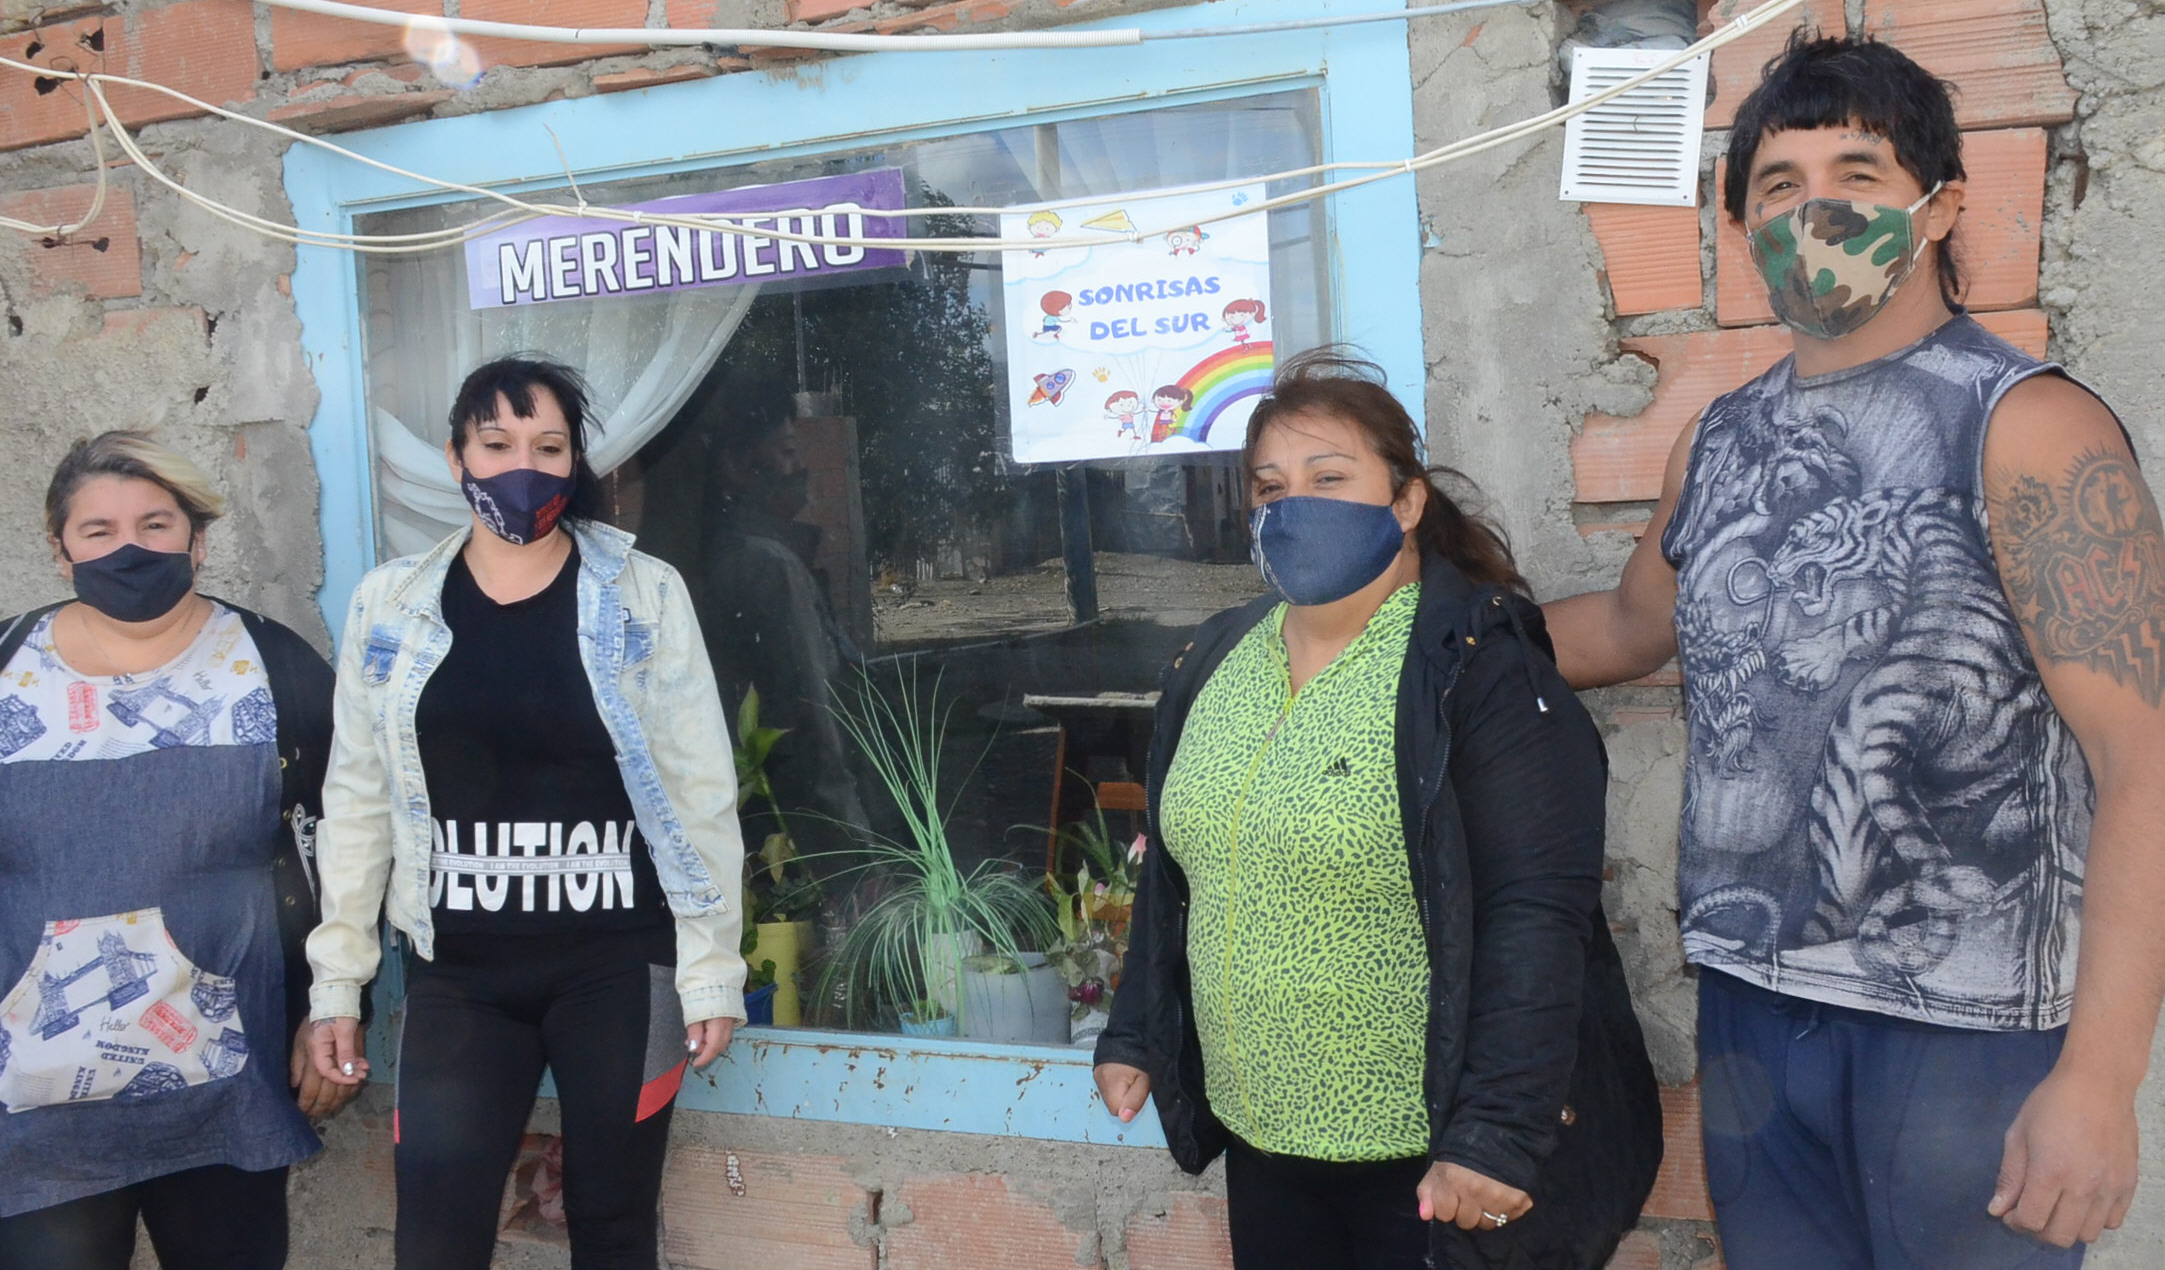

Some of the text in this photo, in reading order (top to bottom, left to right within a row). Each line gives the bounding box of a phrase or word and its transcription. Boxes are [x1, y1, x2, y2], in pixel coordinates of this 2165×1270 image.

[499, 202, 866, 304] MERENDERO
[1078, 276, 1221, 306] SONRISAS
[1090, 312, 1211, 341] DEL SUR
